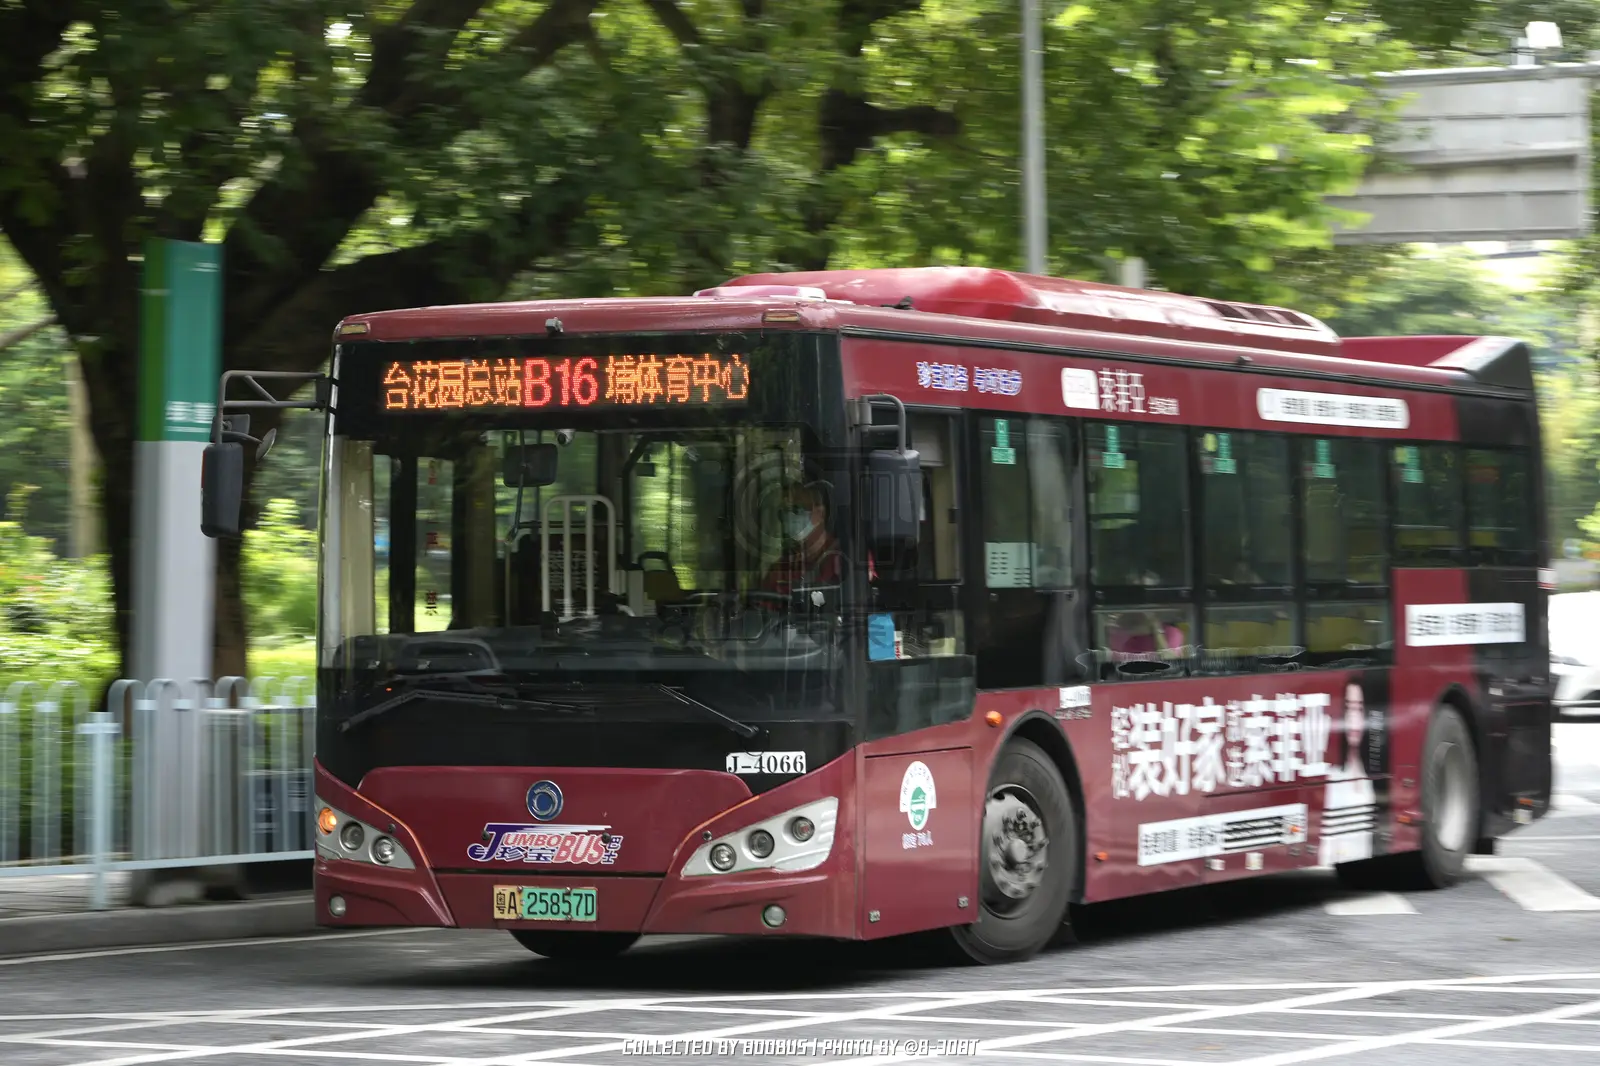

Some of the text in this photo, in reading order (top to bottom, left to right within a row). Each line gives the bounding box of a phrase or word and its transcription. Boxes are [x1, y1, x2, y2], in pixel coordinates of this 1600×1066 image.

[525, 357, 598, 406] B16
[1129, 696, 1226, 801] 装好家
[1243, 692, 1332, 788] 索菲亚
[727, 754, 805, 774] J-4066
[495, 845, 557, 863] 珍宝
[552, 833, 606, 864] BUS
[526, 892, 596, 917] 25857D
